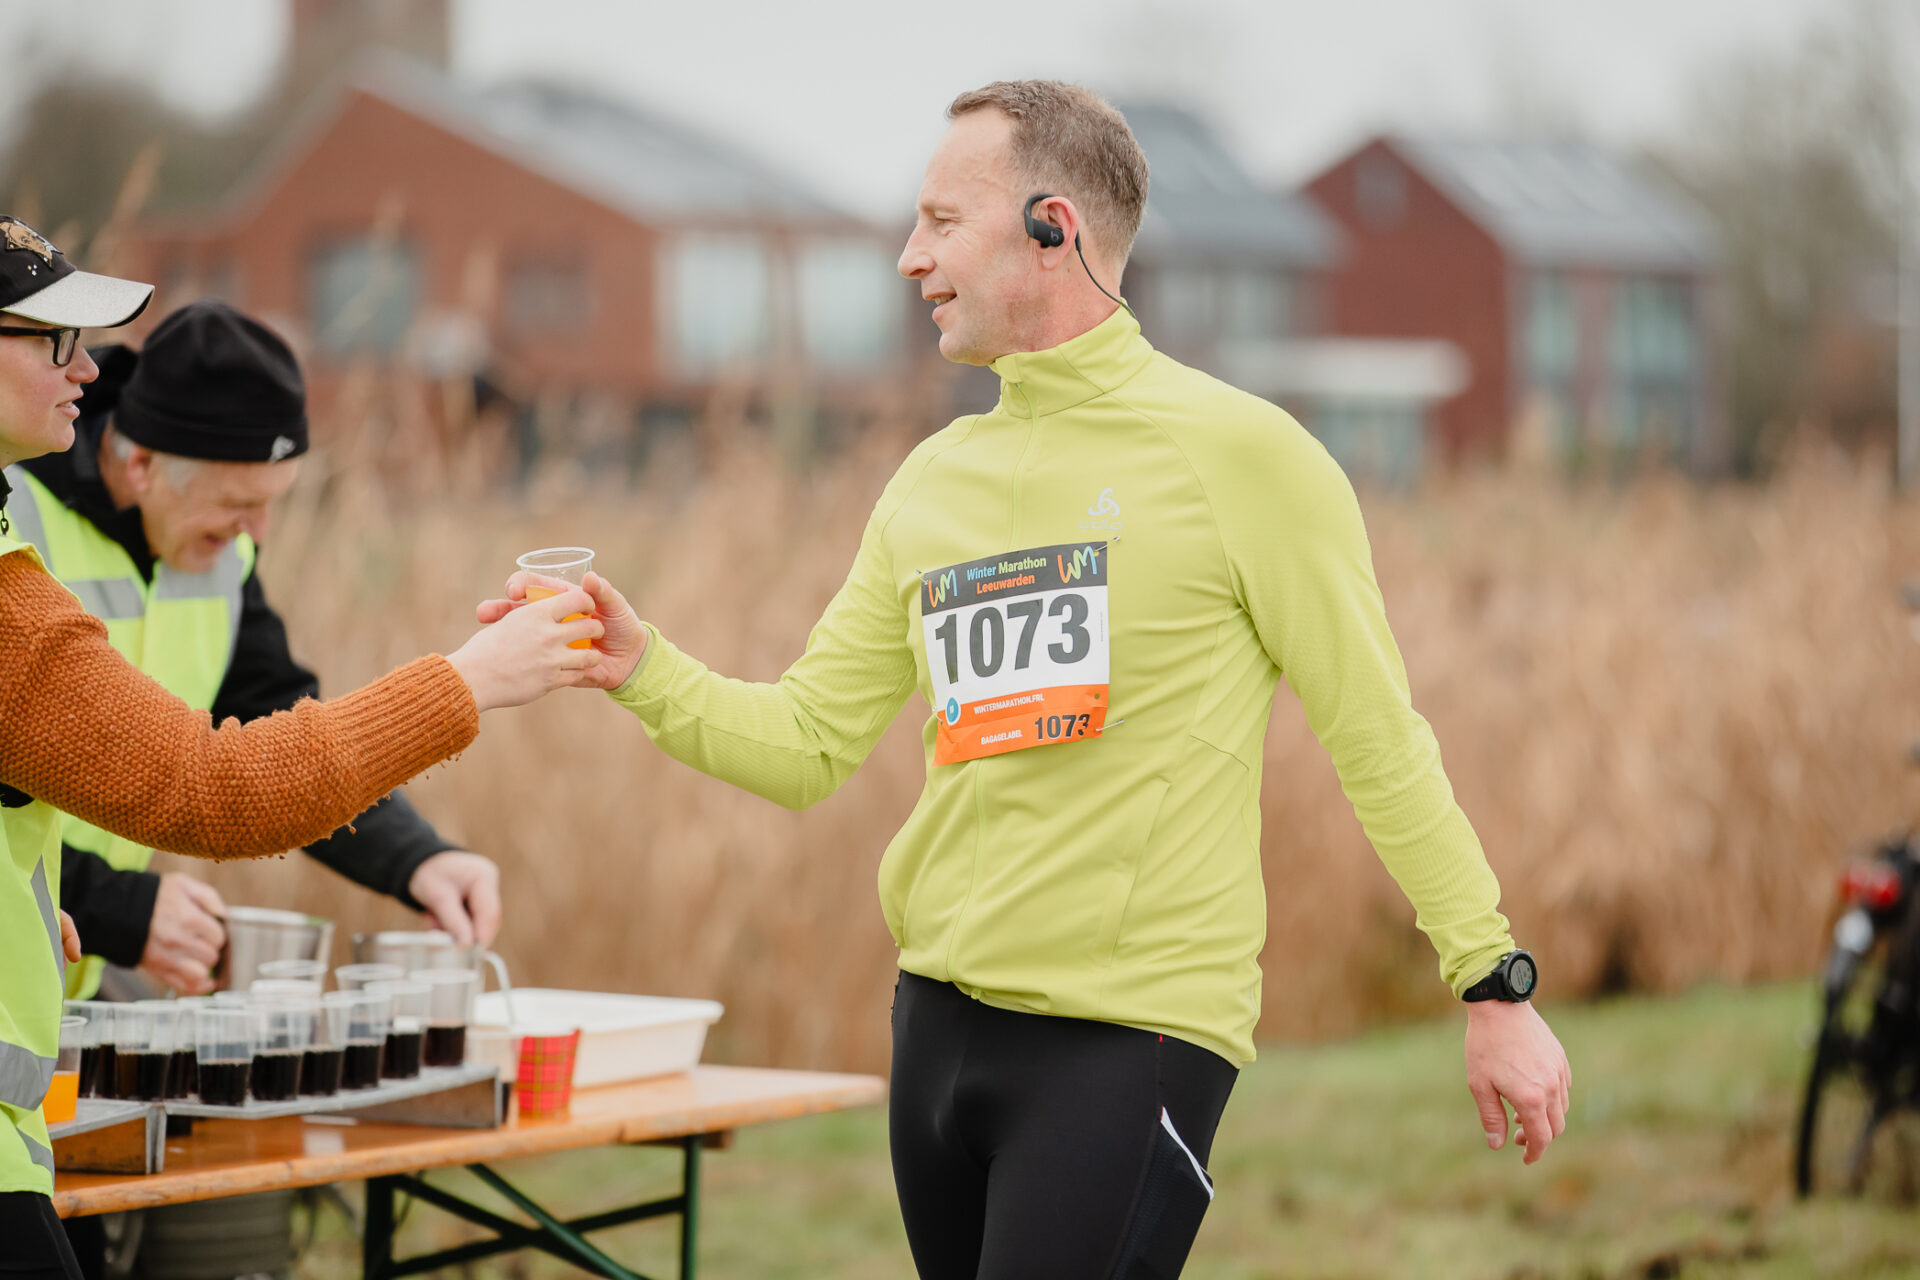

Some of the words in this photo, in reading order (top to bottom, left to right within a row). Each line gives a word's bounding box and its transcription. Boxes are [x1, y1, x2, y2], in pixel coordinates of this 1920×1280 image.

[1080, 519, 1123, 531] odlo
[967, 565, 997, 581] Winter
[998, 556, 1047, 575] Marathon
[976, 573, 1035, 594] Leeuwarden
[935, 593, 1091, 685] 1073
[973, 693, 1045, 715] WINTERMARATHON.FRL
[981, 729, 1023, 745] BAGAGELABEL
[1034, 713, 1090, 740] 1073
